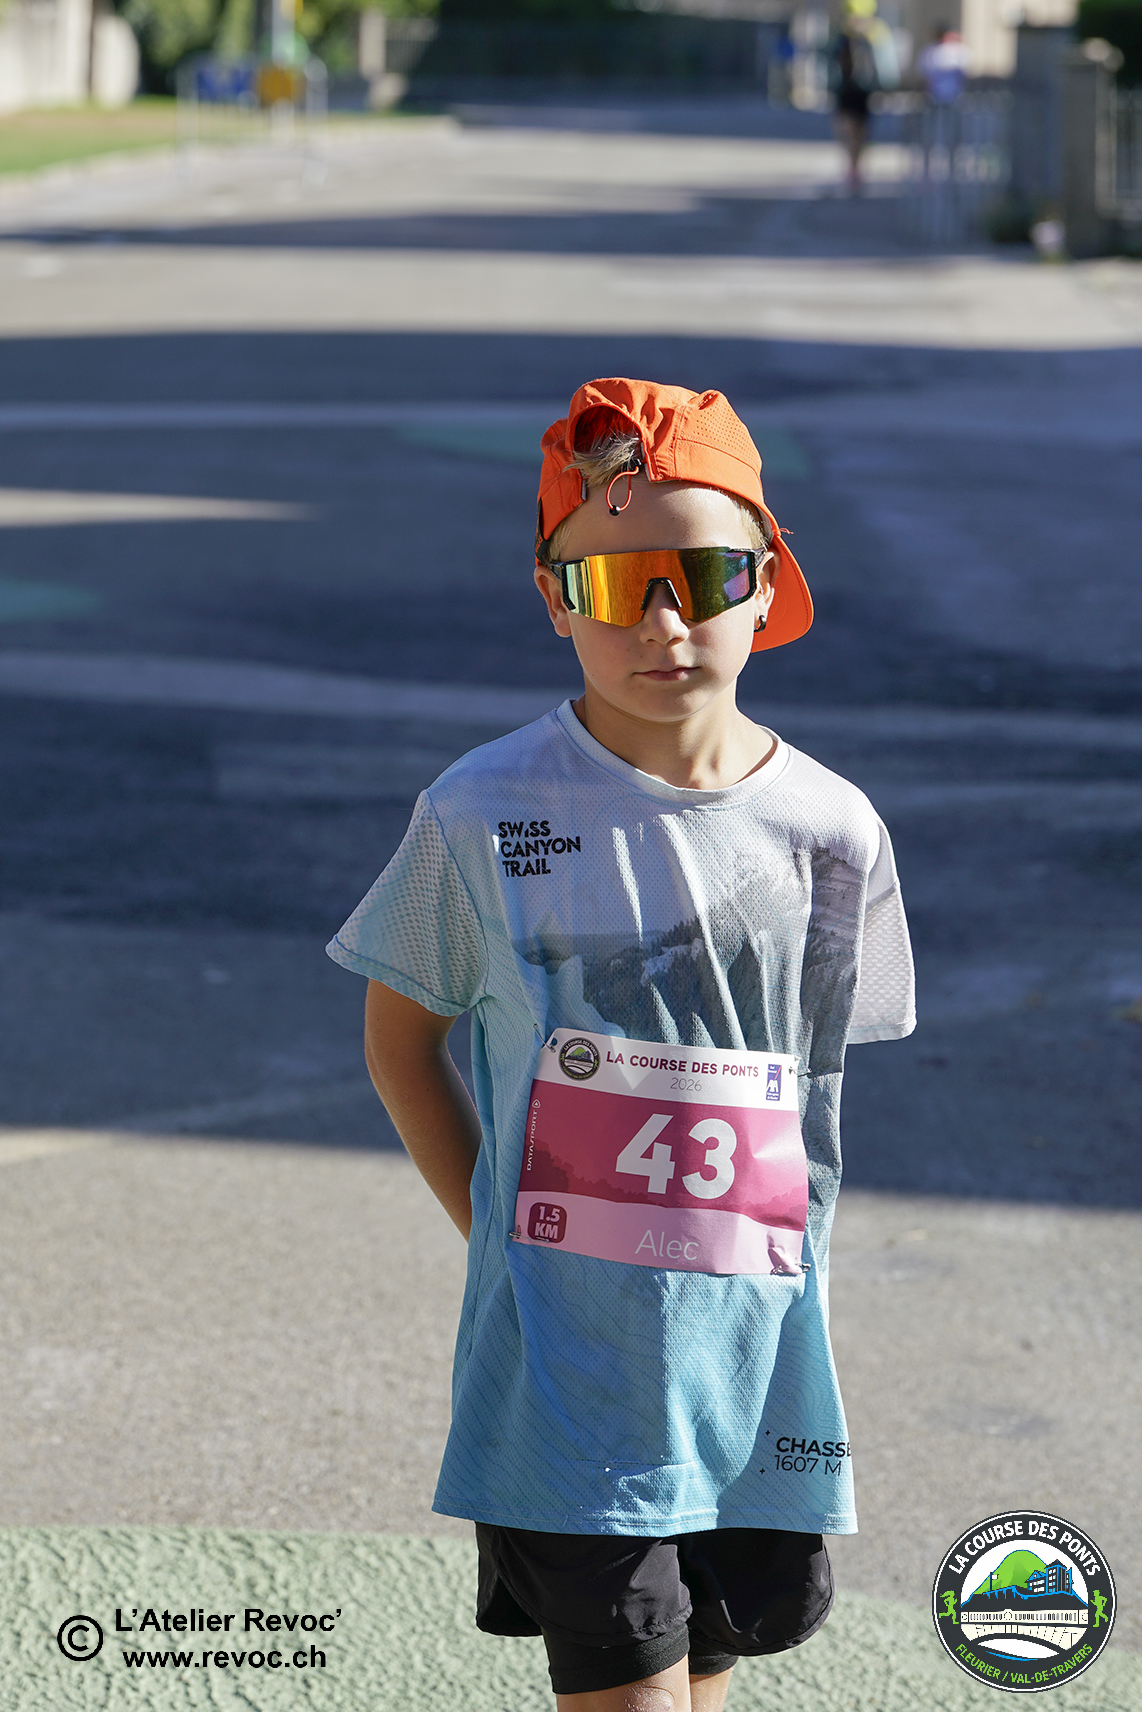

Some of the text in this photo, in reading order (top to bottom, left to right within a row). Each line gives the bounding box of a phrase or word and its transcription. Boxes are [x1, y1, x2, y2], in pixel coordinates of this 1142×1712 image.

[500, 836, 581, 858] CANYON
[502, 858, 551, 877] TRAIL
[606, 1051, 624, 1065] LA
[629, 1055, 687, 1072] COURSE
[691, 1062, 718, 1075] DES
[722, 1064, 759, 1077] PONTS
[670, 1077, 703, 1092] 2026
[526, 1110, 538, 1171] DATASPORT
[615, 1113, 737, 1200] 43
[539, 1206, 561, 1223] 1.5
[534, 1222, 559, 1239] KM
[635, 1229, 699, 1262] Alec
[774, 1454, 841, 1476] 1607 M
